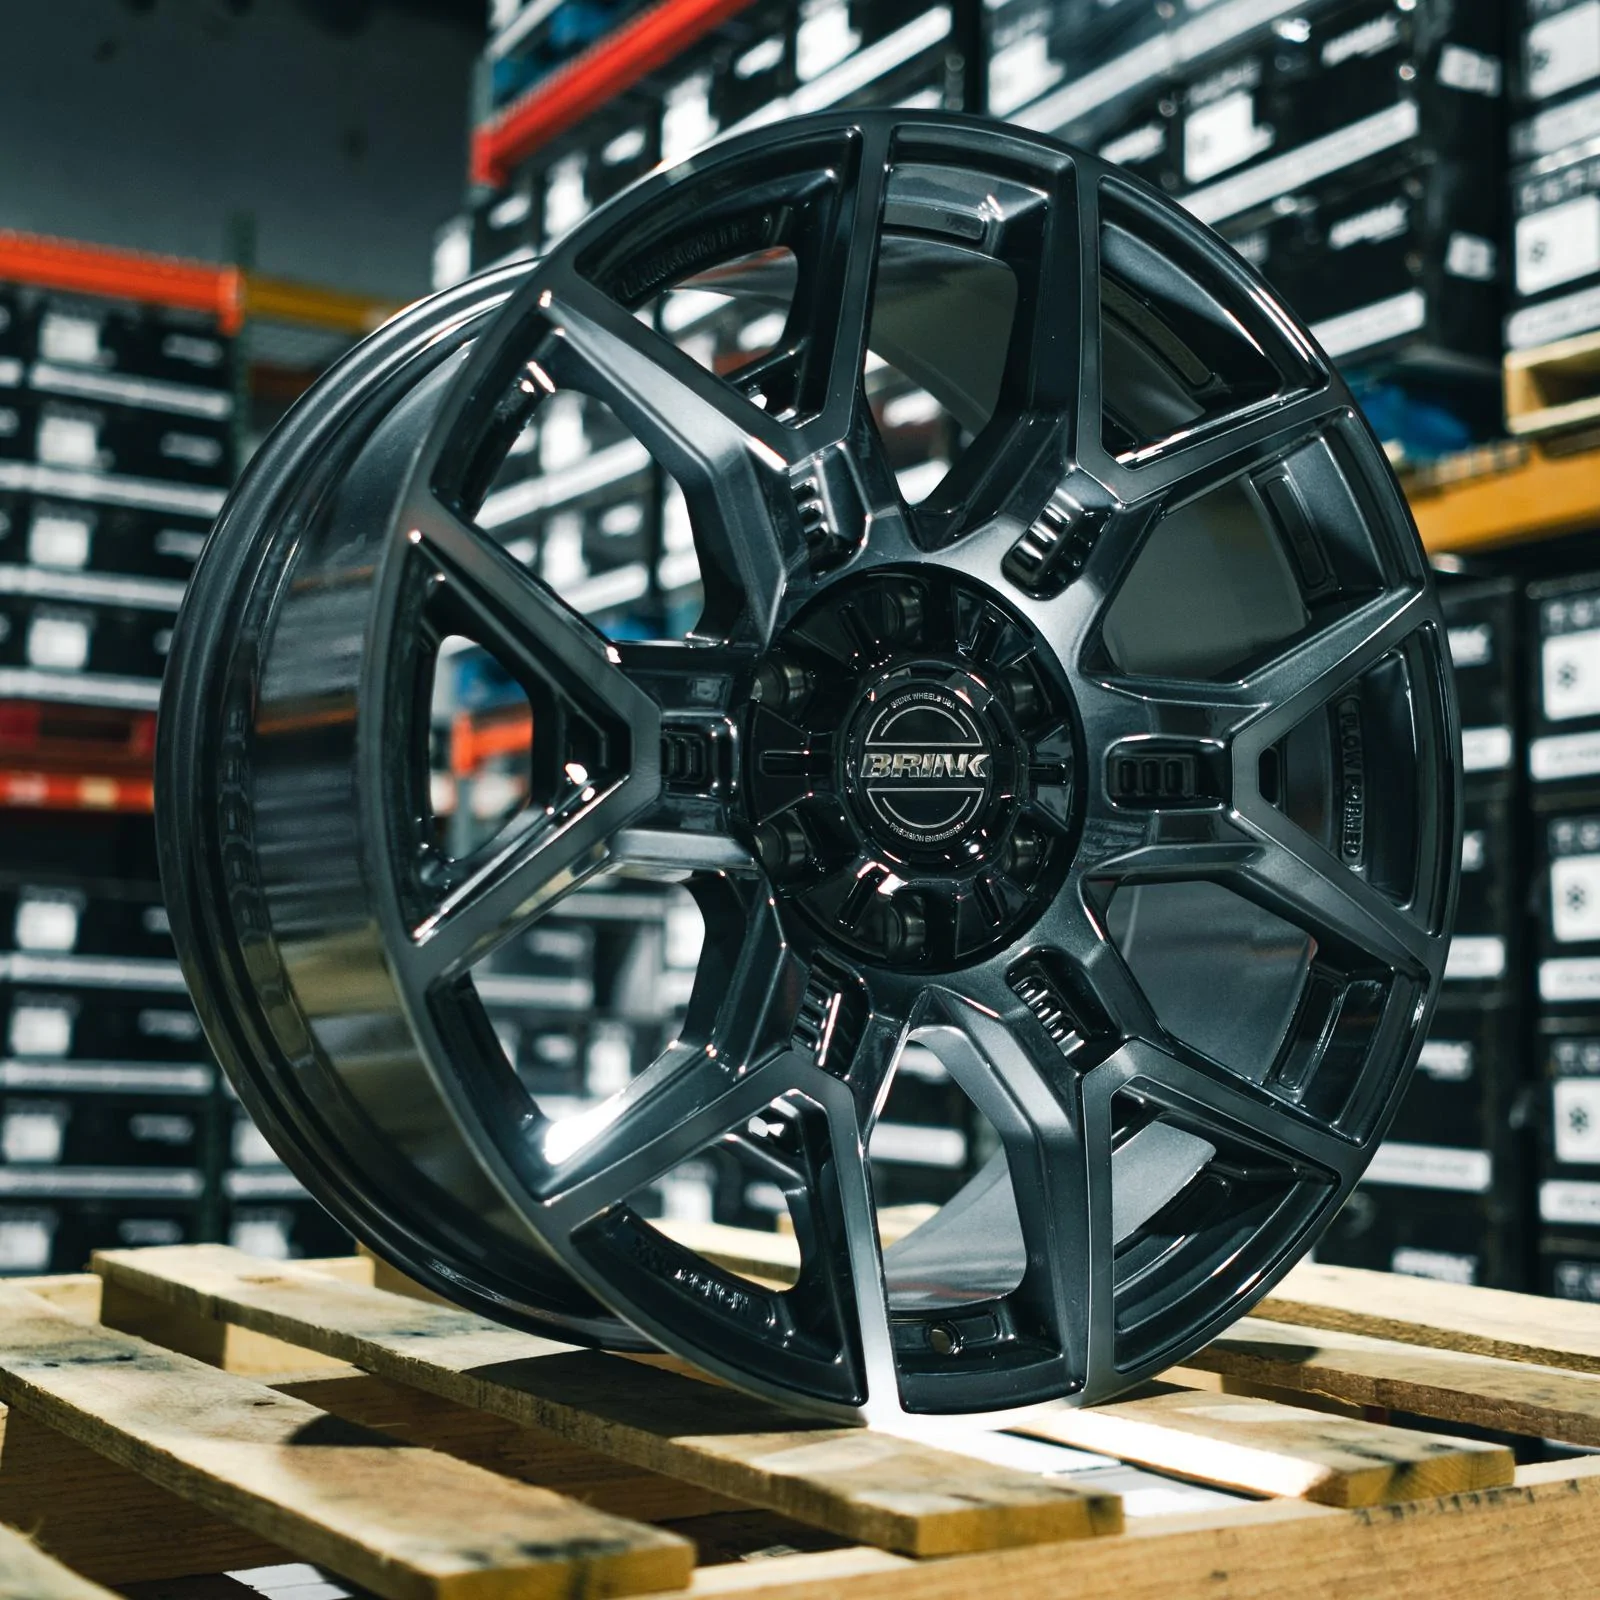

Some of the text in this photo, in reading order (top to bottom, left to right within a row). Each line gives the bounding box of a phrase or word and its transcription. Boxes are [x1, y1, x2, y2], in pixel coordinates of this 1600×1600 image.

[890, 692, 956, 710] BRINK WHEELS USA
[860, 753, 990, 778] BRINK
[1341, 712, 1364, 859] FLOW FORMED
[889, 821, 965, 843] PRECISION ENGINEERED
